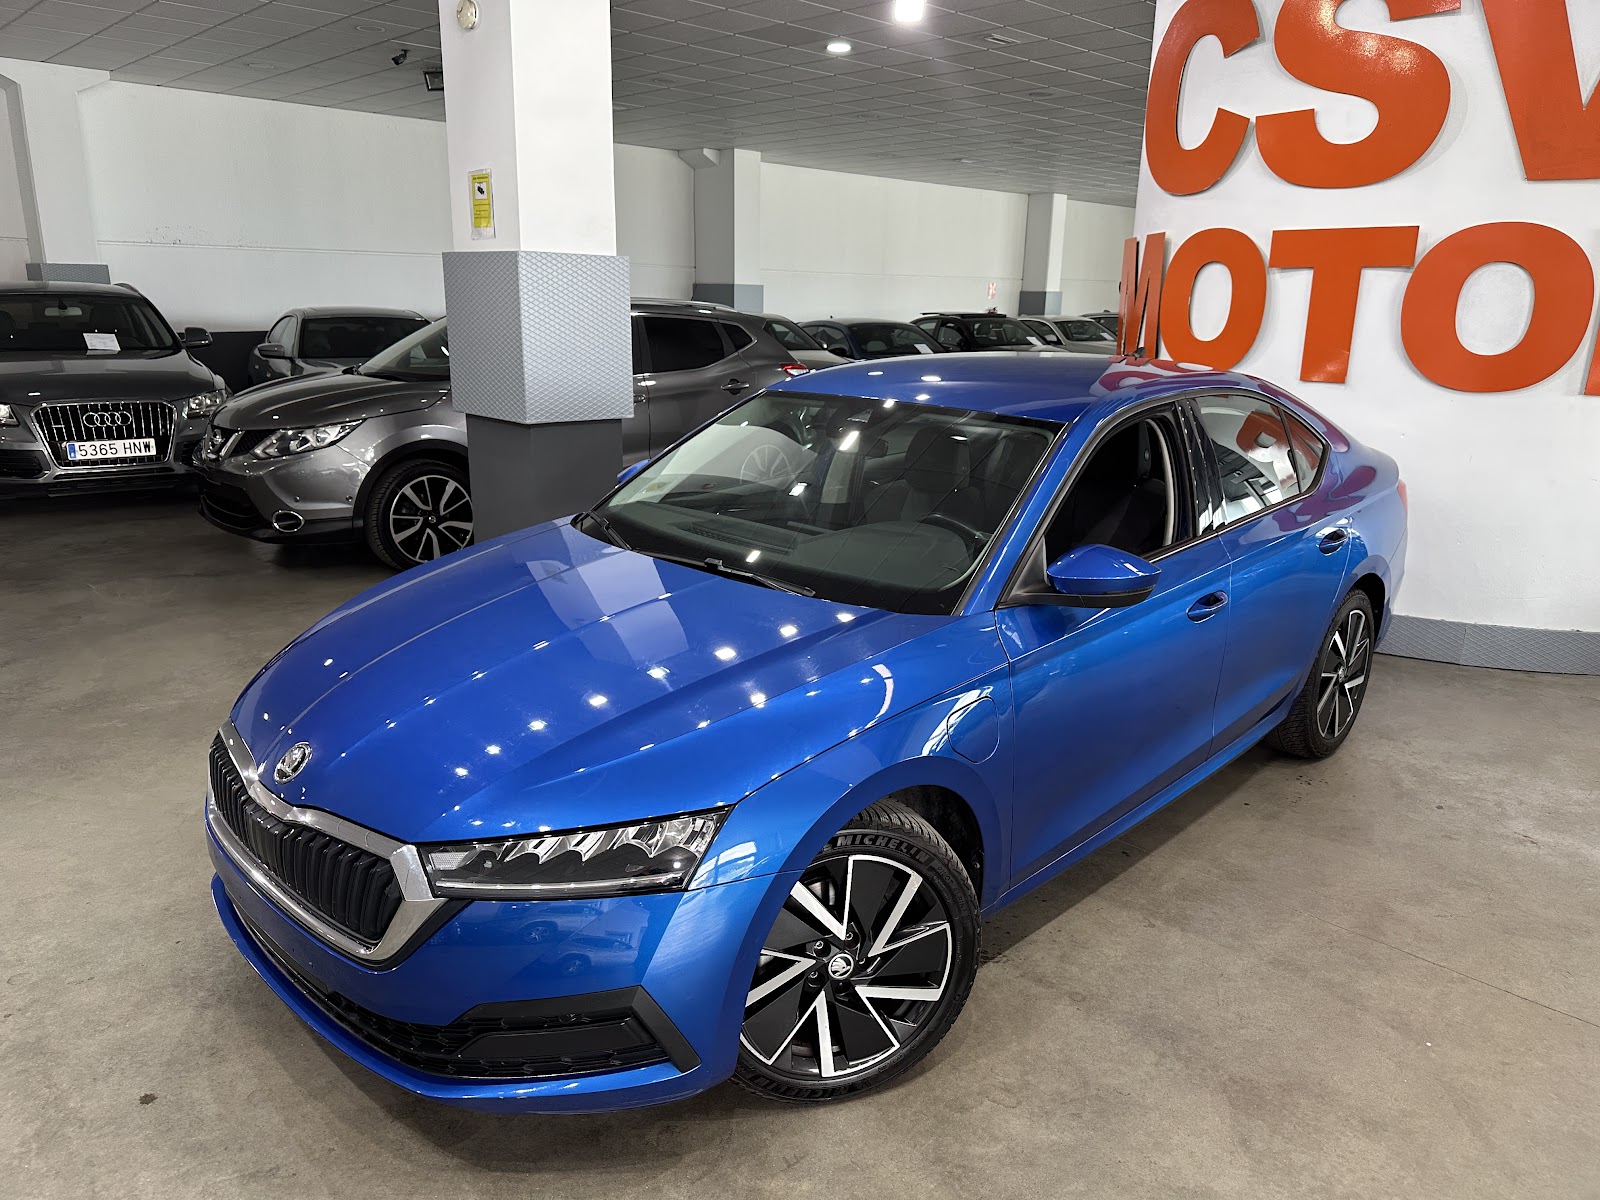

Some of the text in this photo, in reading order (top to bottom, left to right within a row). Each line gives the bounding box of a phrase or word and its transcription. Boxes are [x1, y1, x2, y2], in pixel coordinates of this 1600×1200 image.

[1117, 222, 1600, 396] MOTO
[78, 441, 151, 457] 5365 HNW
[836, 834, 931, 864] MICHELIN
